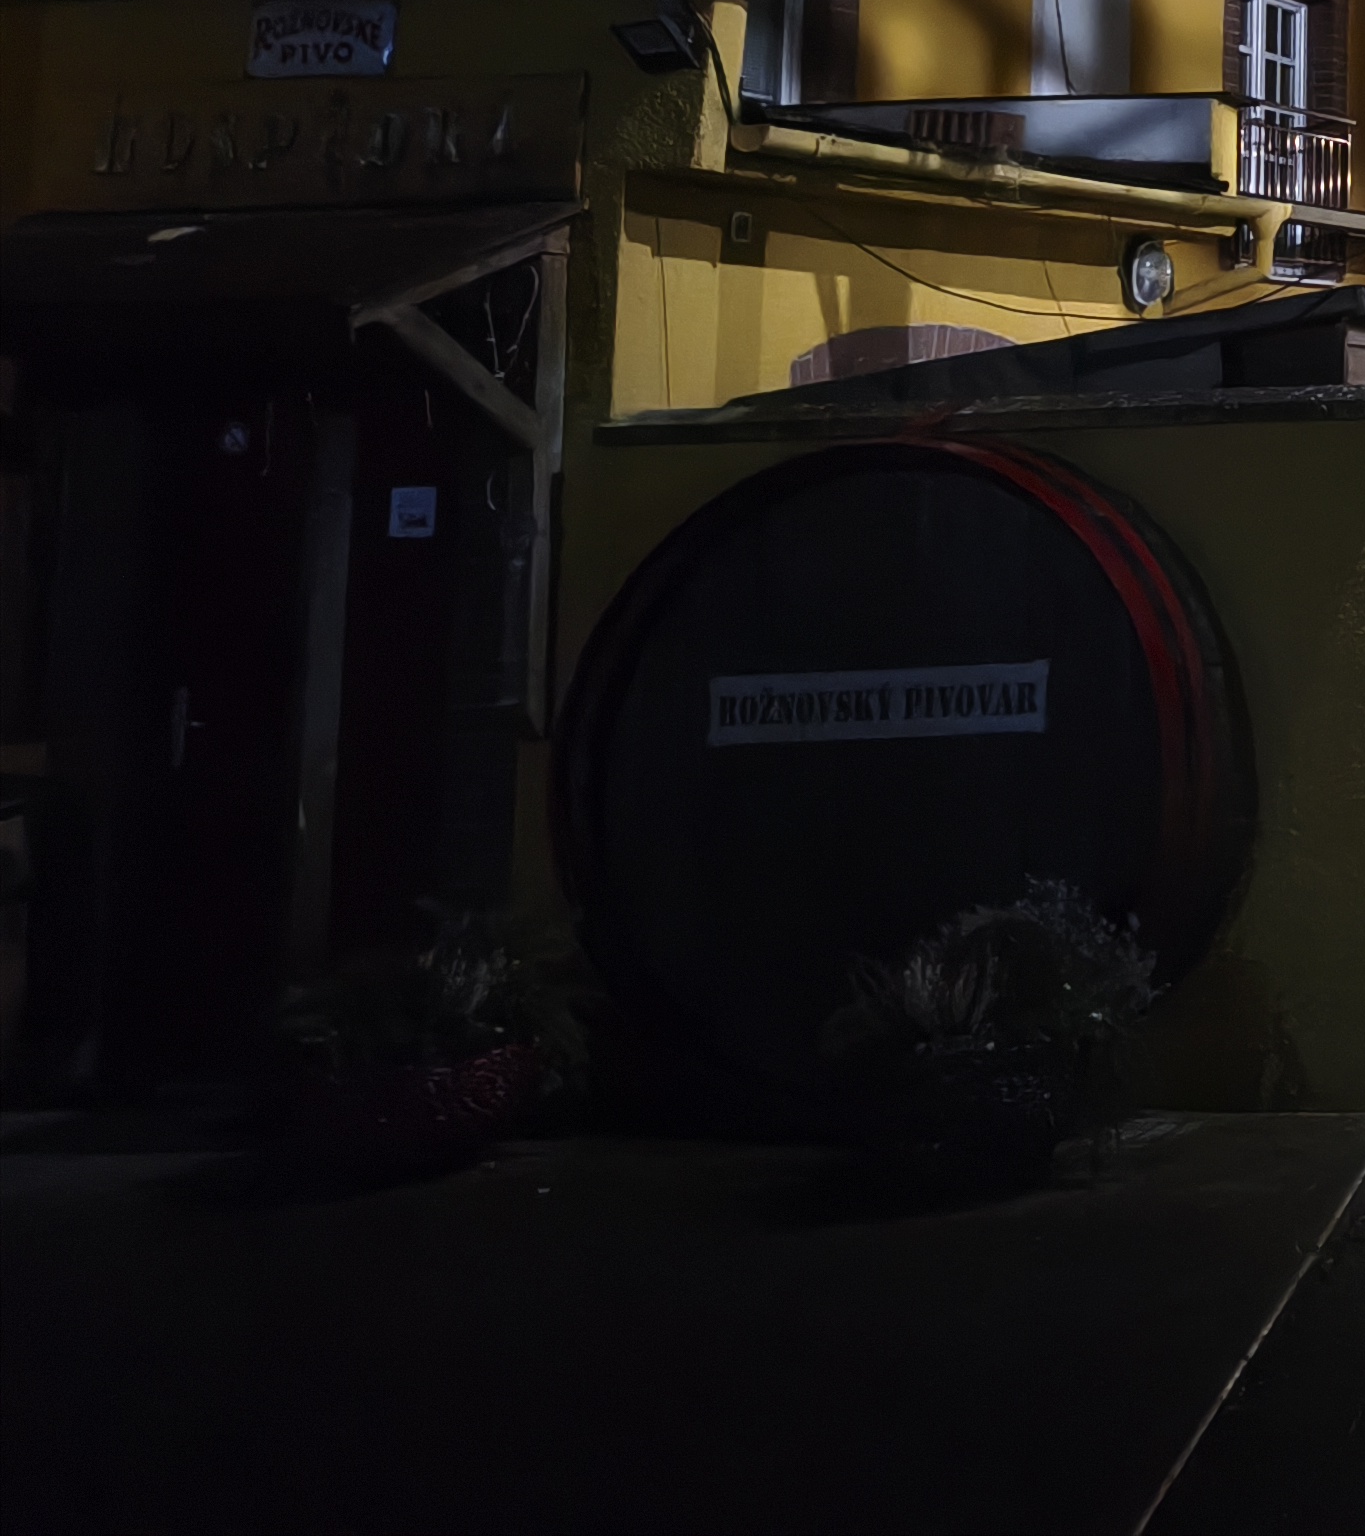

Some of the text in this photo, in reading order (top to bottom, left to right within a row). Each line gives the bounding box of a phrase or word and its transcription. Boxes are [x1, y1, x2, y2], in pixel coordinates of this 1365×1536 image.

[280, 41, 354, 64] PIVO
[718, 680, 1038, 727] ROŽNOVSKÝ PIVOVAR
